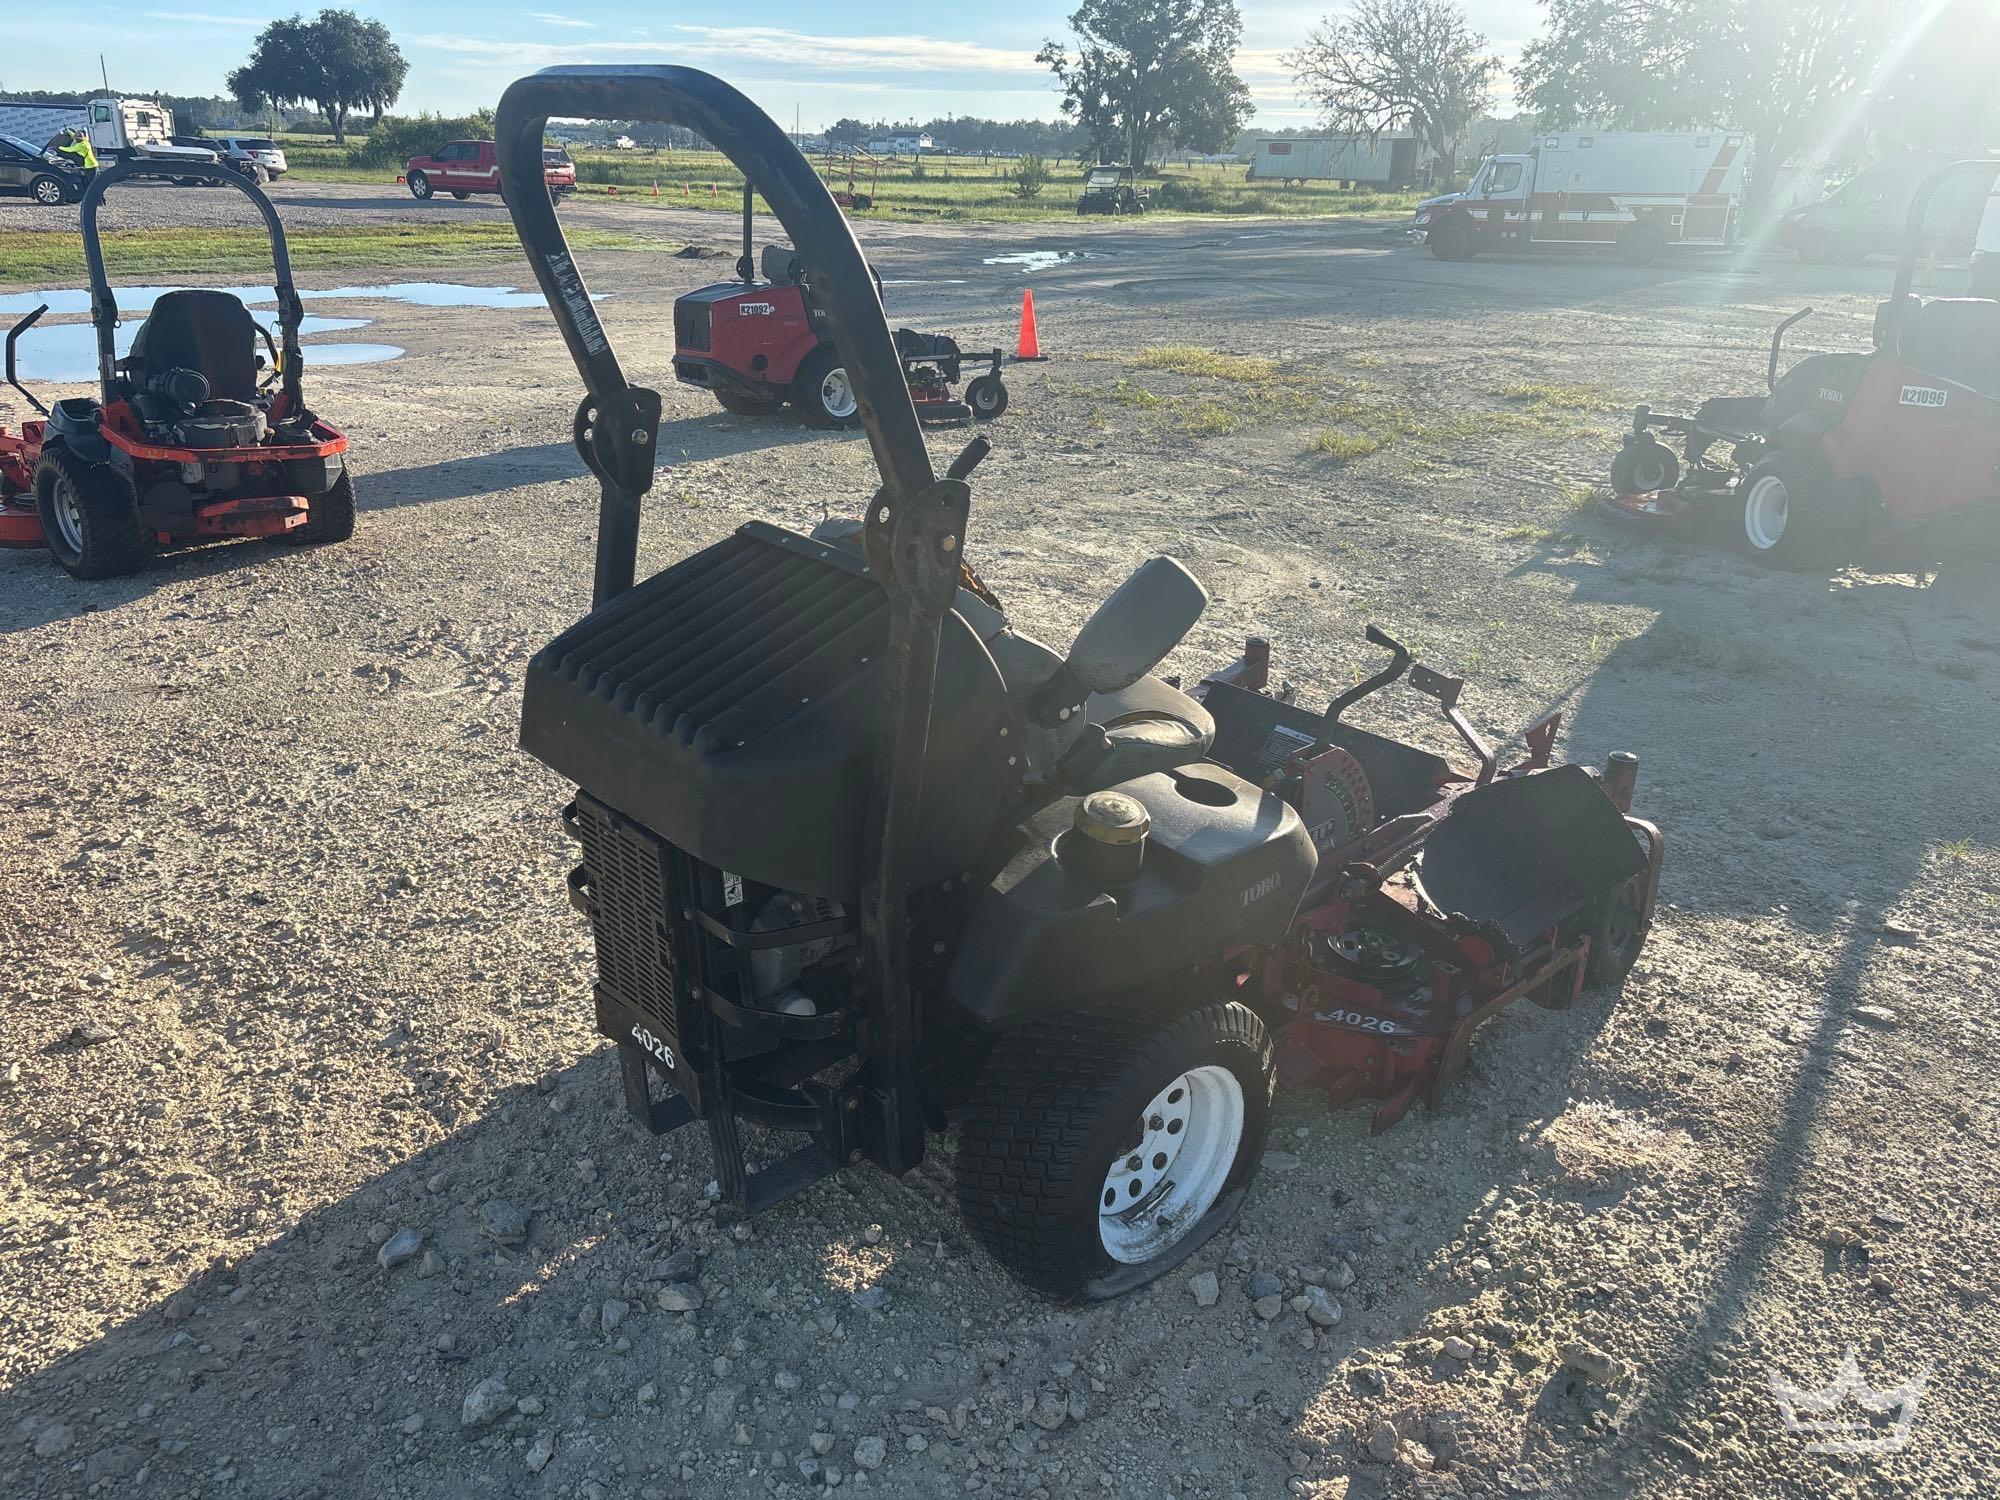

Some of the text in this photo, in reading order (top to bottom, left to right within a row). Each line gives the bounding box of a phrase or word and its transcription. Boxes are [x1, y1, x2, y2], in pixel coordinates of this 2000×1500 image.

[1902, 388, 1945, 405] K21096
[1240, 872, 1281, 908] TORO
[1328, 1008, 1396, 1034] 4026
[631, 1022, 675, 1069] 4026
